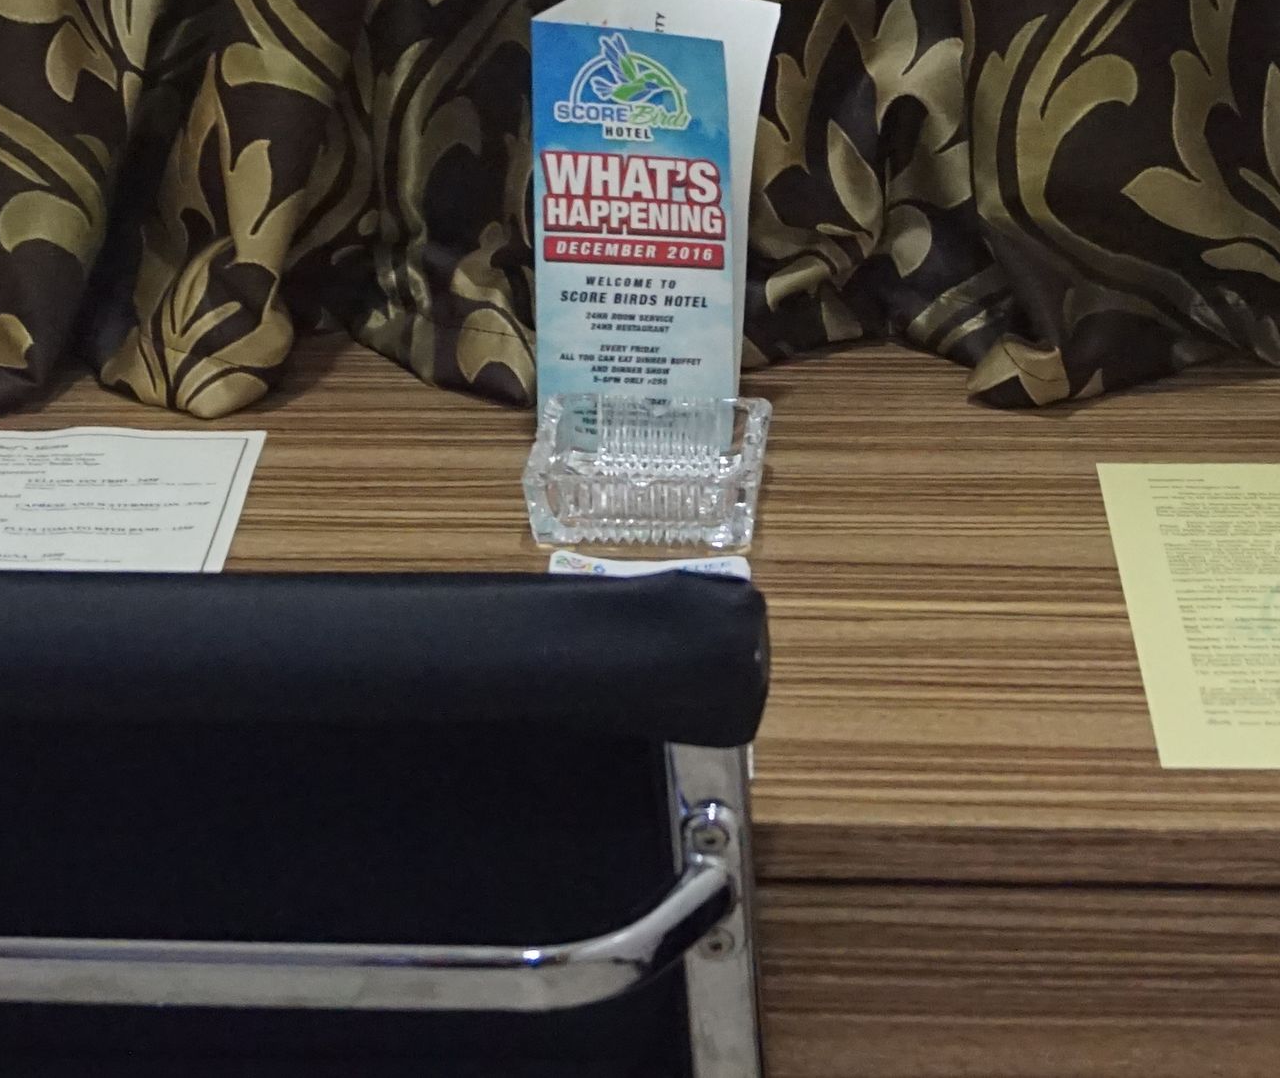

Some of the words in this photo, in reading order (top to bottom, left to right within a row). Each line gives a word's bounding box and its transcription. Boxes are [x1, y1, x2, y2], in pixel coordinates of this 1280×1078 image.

[557, 104, 628, 123] SCORE
[630, 105, 690, 128] Birds
[605, 125, 652, 139] HOTEL
[545, 153, 719, 203] WHAT'S
[547, 198, 722, 234] HAPPENING
[556, 241, 656, 258] DECEMBER
[667, 248, 713, 261] 2016
[586, 276, 653, 289] WELCOME
[660, 279, 677, 289] TO
[560, 291, 608, 304] SCORE
[614, 293, 657, 306] BIRDS
[664, 295, 709, 308] HOTEL
[586, 312, 608, 320] 24HR
[611, 313, 636, 321] ROOM
[639, 314, 674, 323] SERVICE
[591, 323, 613, 331] 24HR
[616, 324, 669, 333] RESTAURANT
[630, 346, 660, 354] FRIDAY
[560, 353, 575, 361] ALL
[578, 354, 595, 362] YOU
[598, 354, 615, 362] CAN
[618, 355, 633, 363] EAT
[636, 356, 667, 364] DINNER
[671, 357, 702, 366] BUFFET
[591, 365, 608, 373] AND
[611, 366, 642, 374] DINNER
[645, 367, 670, 375] SHOW
[624, 377, 644, 385] ONLY
